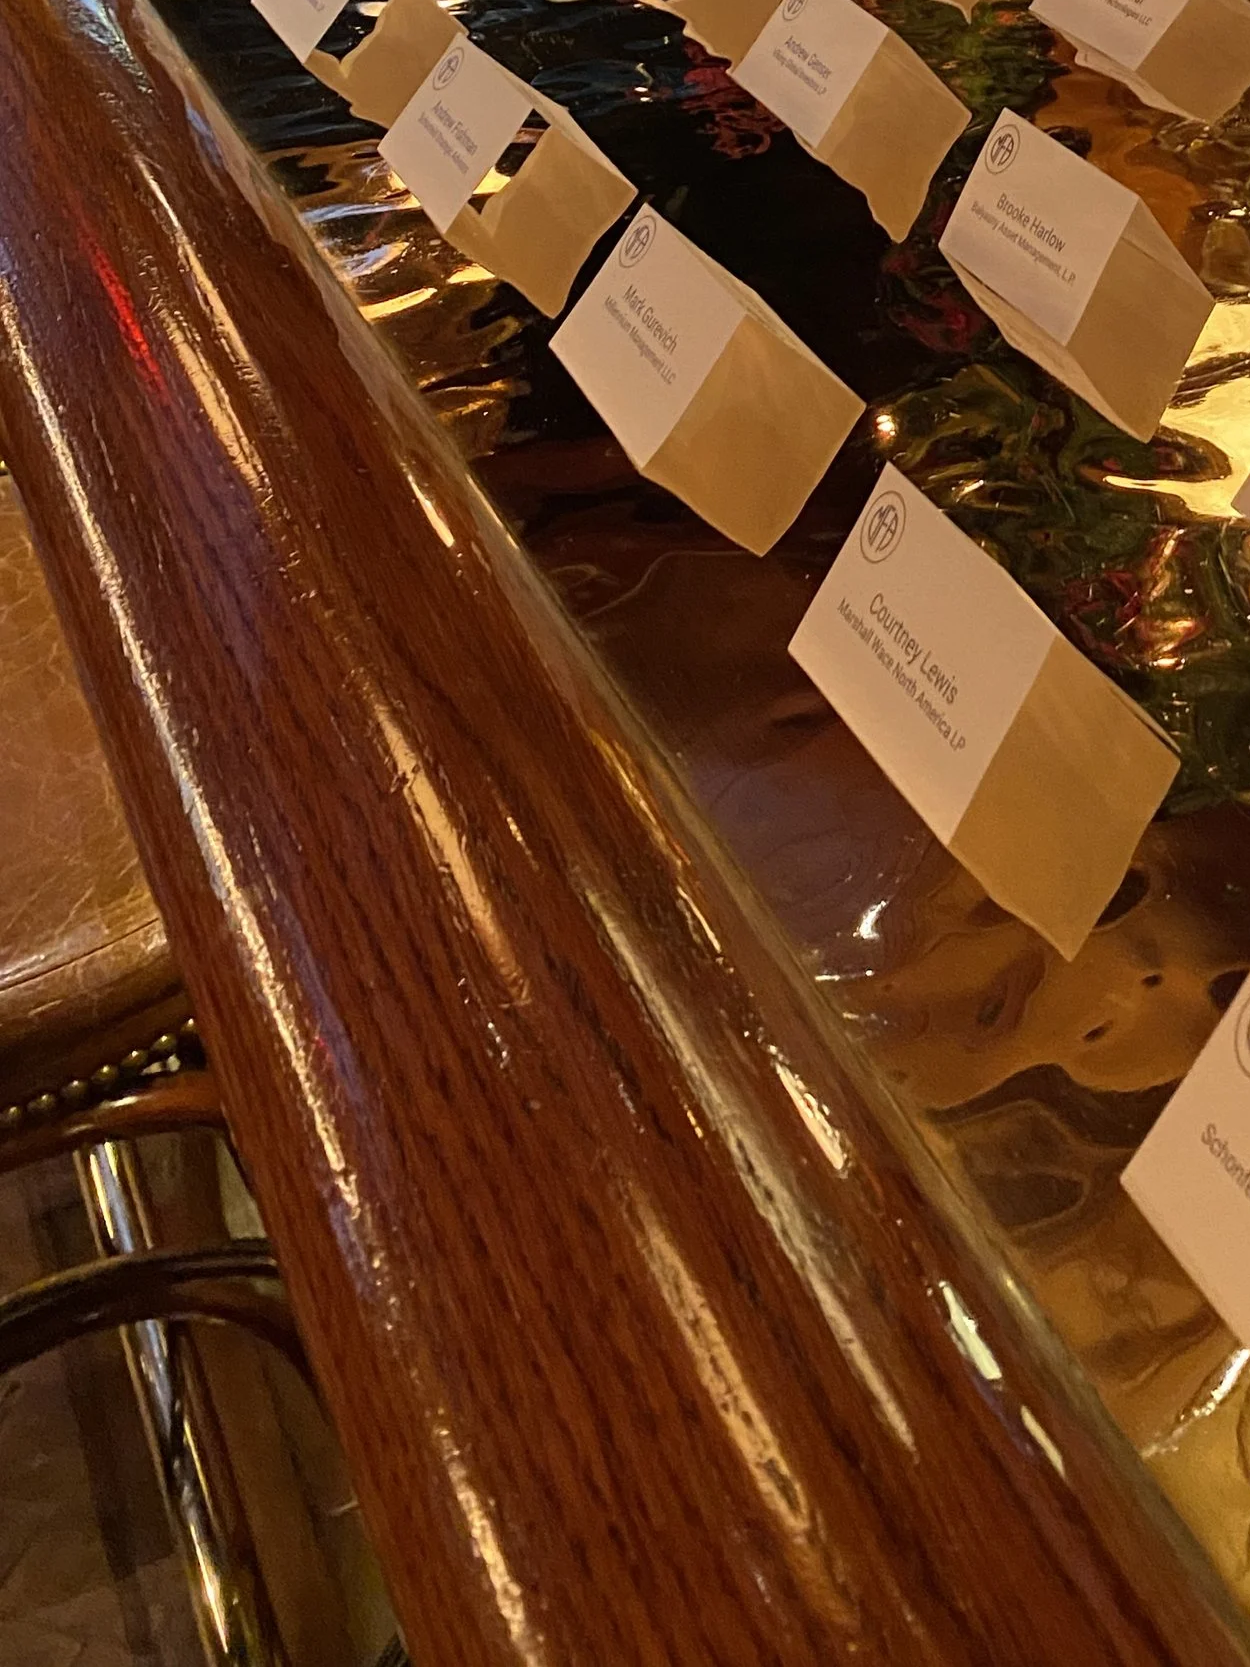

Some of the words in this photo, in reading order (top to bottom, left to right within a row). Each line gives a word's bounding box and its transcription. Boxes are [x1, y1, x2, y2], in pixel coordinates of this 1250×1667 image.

[995, 191, 1032, 230] Brooke
[1027, 215, 1067, 254] Harlow
[996, 220, 1021, 245] Asset
[621, 283, 648, 318] Mark
[640, 305, 679, 357] Gurevich
[627, 324, 667, 375] Management
[659, 363, 678, 387] LLC
[836, 596, 876, 646] Marshall
[870, 633, 896, 672] Wace
[890, 660, 918, 700] North
[913, 689, 953, 741] America
[948, 729, 967, 752] LP
[868, 591, 924, 668] Courtney
[918, 649, 959, 706] Lewis
